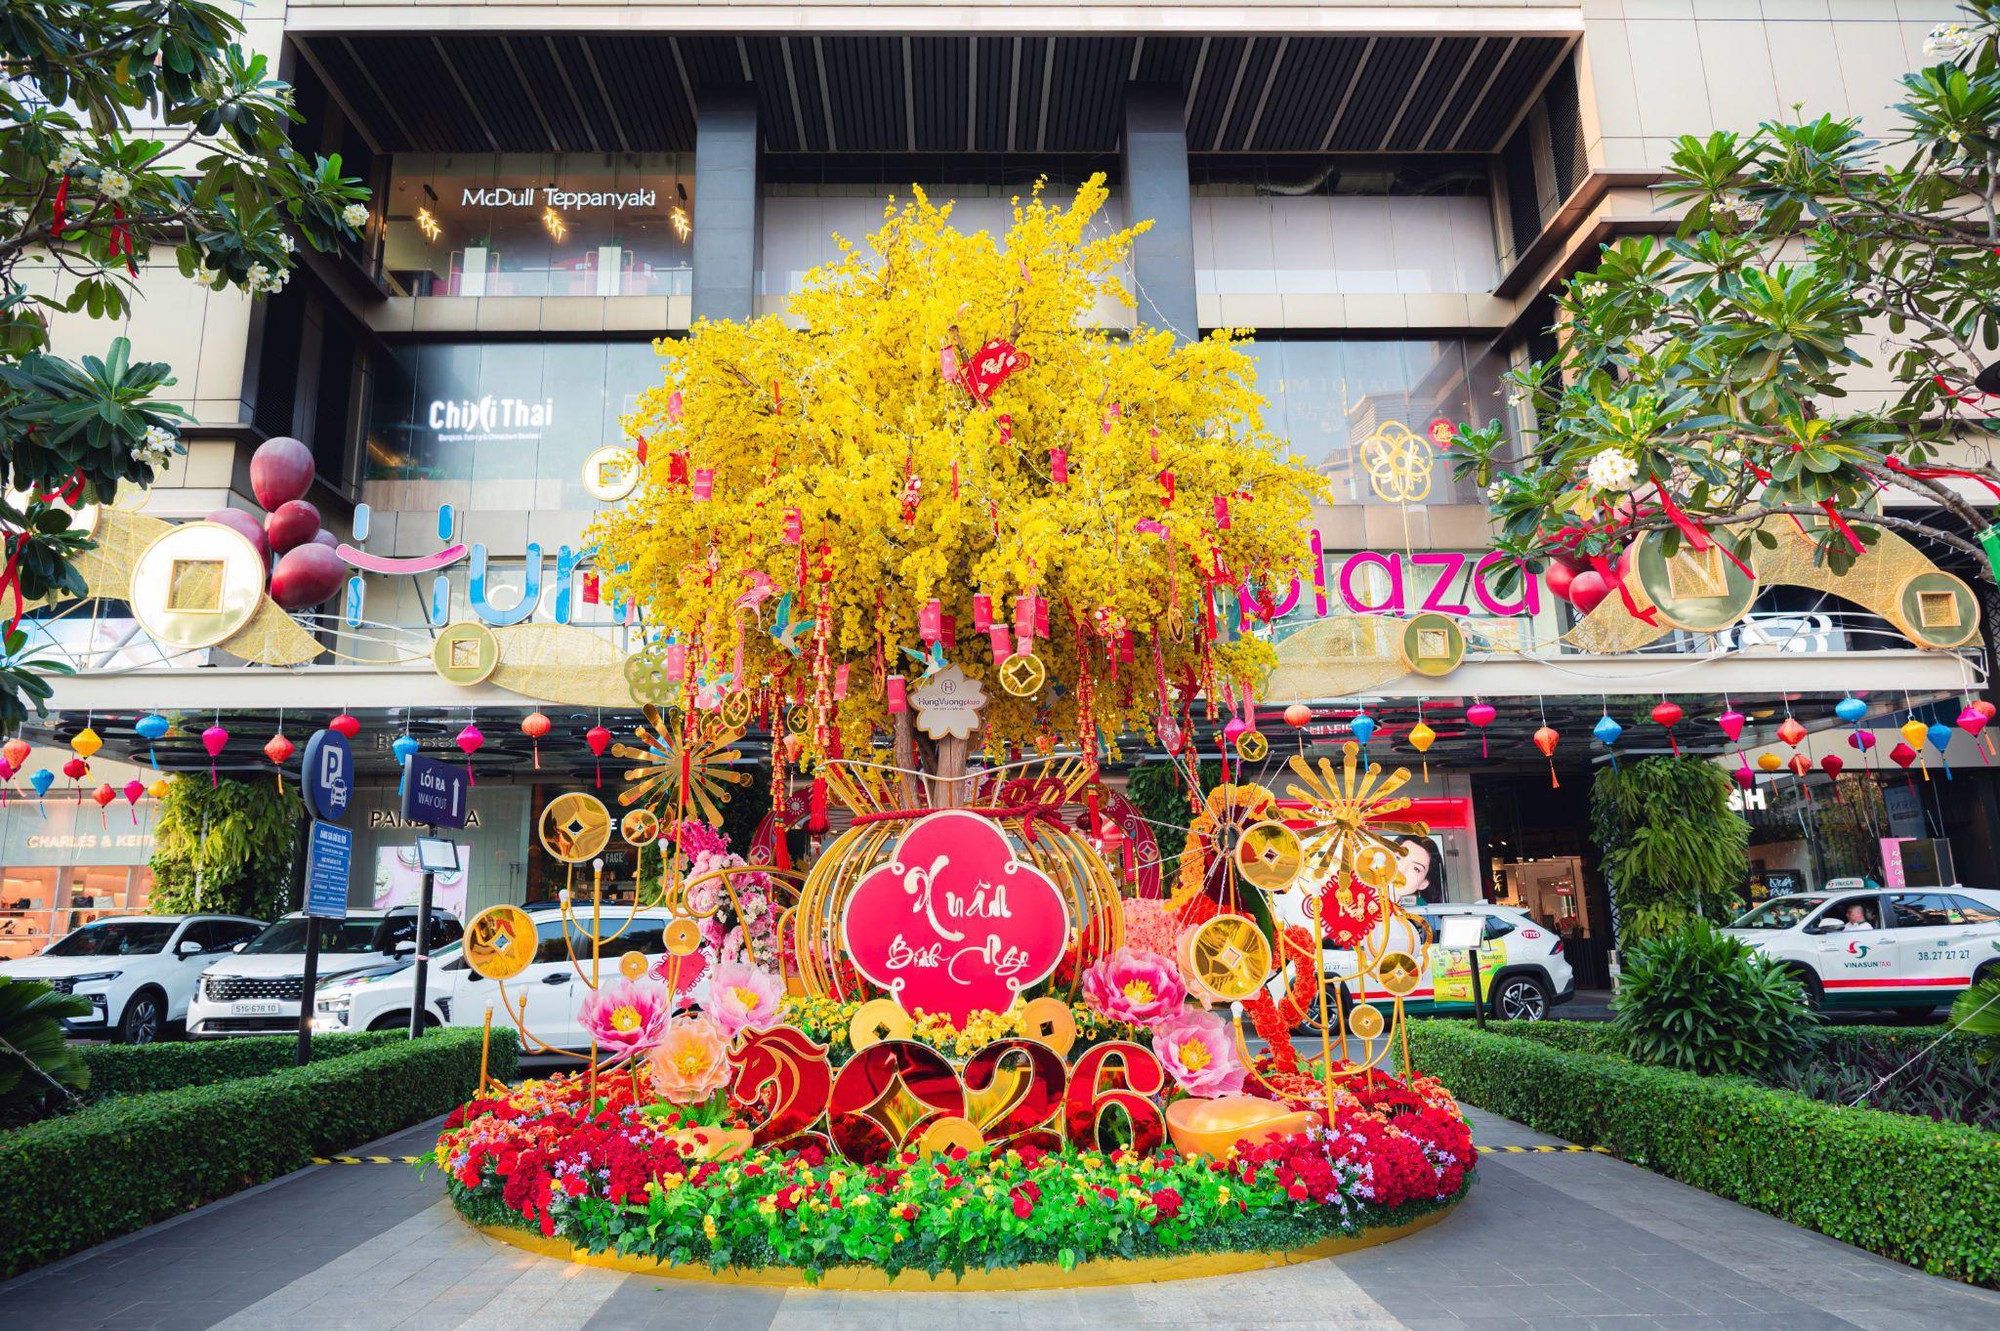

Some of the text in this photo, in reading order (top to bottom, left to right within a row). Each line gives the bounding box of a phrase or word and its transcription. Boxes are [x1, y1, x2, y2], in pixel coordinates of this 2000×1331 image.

[461, 188, 656, 210] McDull Teppanyaki
[501, 398, 553, 427] Thai
[420, 768, 446, 792] LỐI RA
[418, 792, 448, 809] WAY OUT
[369, 810, 481, 828] PANA
[26, 834, 97, 849] CHARLES
[101, 835, 112, 848] &
[605, 852, 623, 863] FACE
[1918, 950, 1970, 961] 38.27 27 27
[725, 1025, 1167, 1163] 2026
